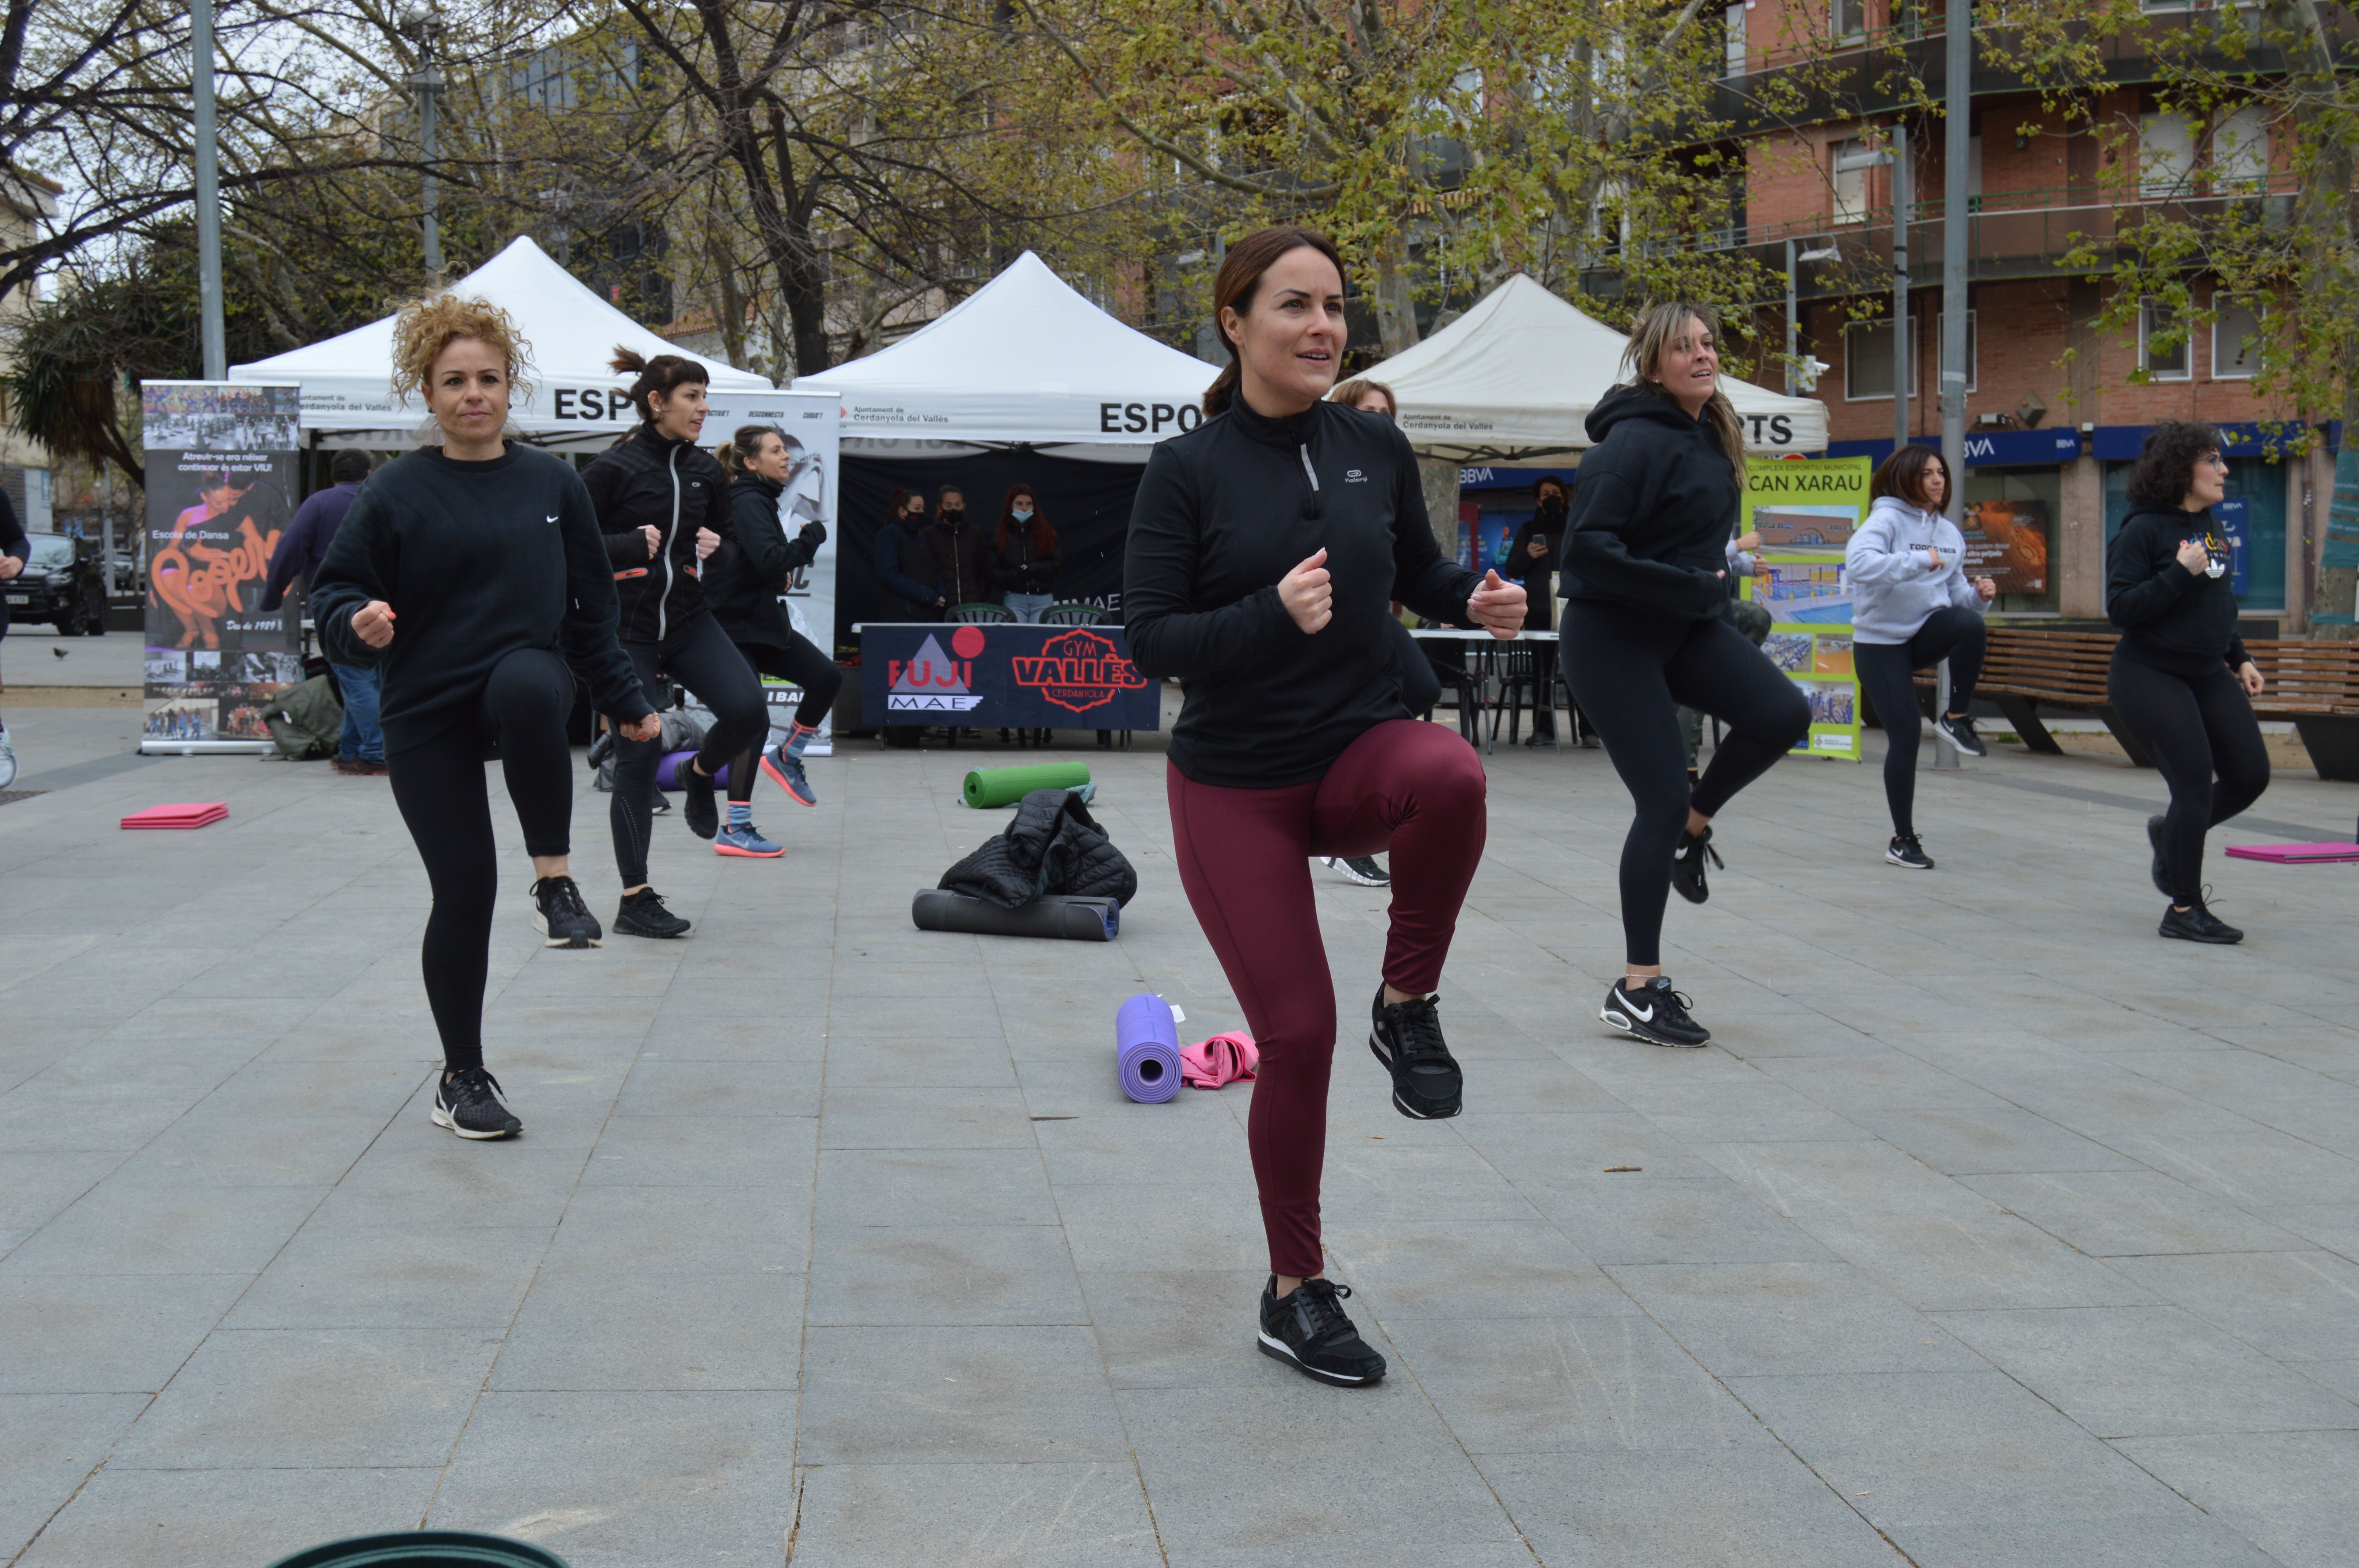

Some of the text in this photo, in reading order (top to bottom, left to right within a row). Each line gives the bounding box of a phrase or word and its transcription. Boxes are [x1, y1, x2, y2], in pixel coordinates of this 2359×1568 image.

[554, 388, 632, 420] ESP
[854, 414, 903, 423] Cerdanyola
[1100, 403, 1203, 433] ESPO
[1403, 421, 1451, 430] Cerdanyola
[1469, 422, 1493, 430] Vallès
[2056, 439, 2075, 448] BBVA
[182, 452, 225, 461] Atrevir-se
[220, 463, 230, 472] és
[1460, 467, 1494, 484] BBVA
[1749, 475, 1863, 491] CAN XARAU
[152, 530, 229, 539] Escola de Dansa
[1063, 641, 1097, 657] GYM
[888, 660, 972, 688] FUJI
[1052, 689, 1105, 699] CERDANYOLA
[890, 697, 966, 709] MAE
